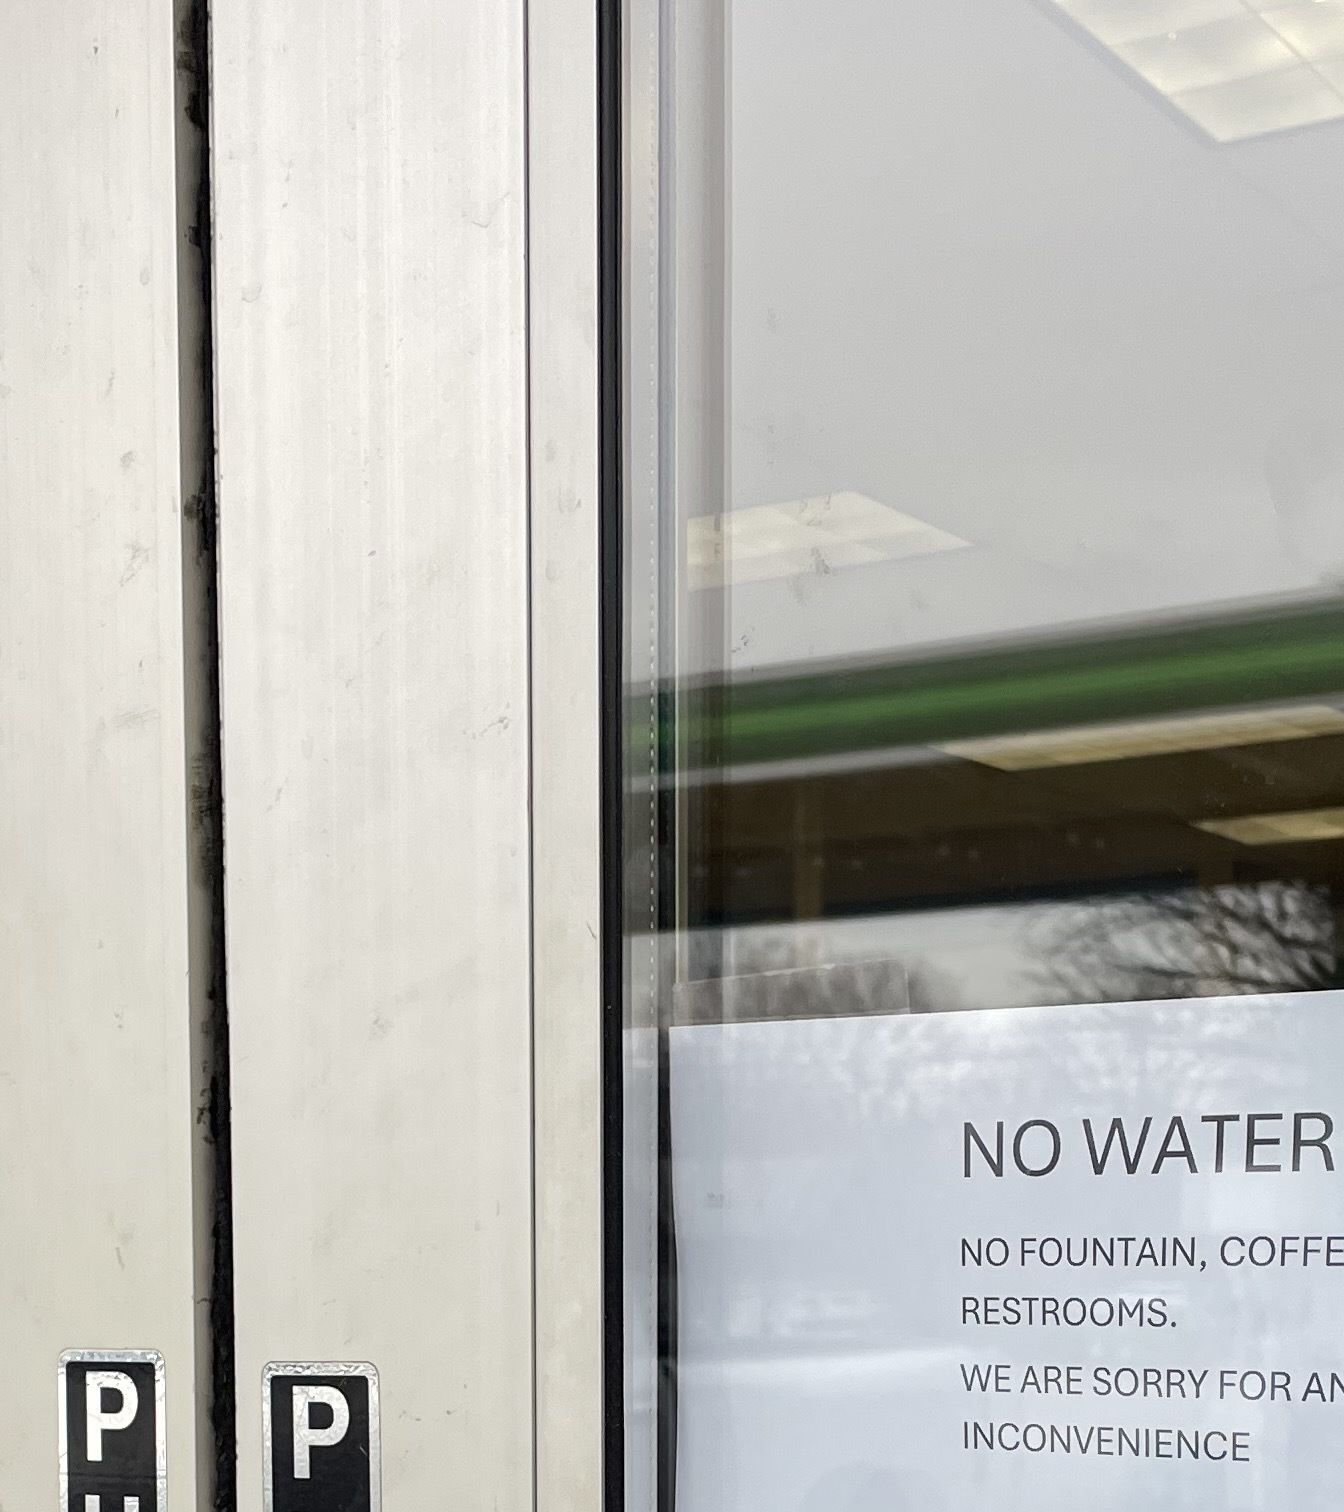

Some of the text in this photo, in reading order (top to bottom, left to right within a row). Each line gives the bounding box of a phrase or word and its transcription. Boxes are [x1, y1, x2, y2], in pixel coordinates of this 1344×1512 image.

[963, 1111, 1336, 1179] NO WATER
[960, 1237, 1009, 1267] NO
[1021, 1237, 1207, 1271] FOUNTAIN,
[961, 1296, 1178, 1328] RESTROOMS.
[960, 1363, 1012, 1393] WE
[1020, 1364, 1083, 1396] ARE
[1093, 1367, 1208, 1400] SORRY
[1219, 1369, 1292, 1402] FOR
[962, 1421, 1250, 1462] INCONVENIENCE
